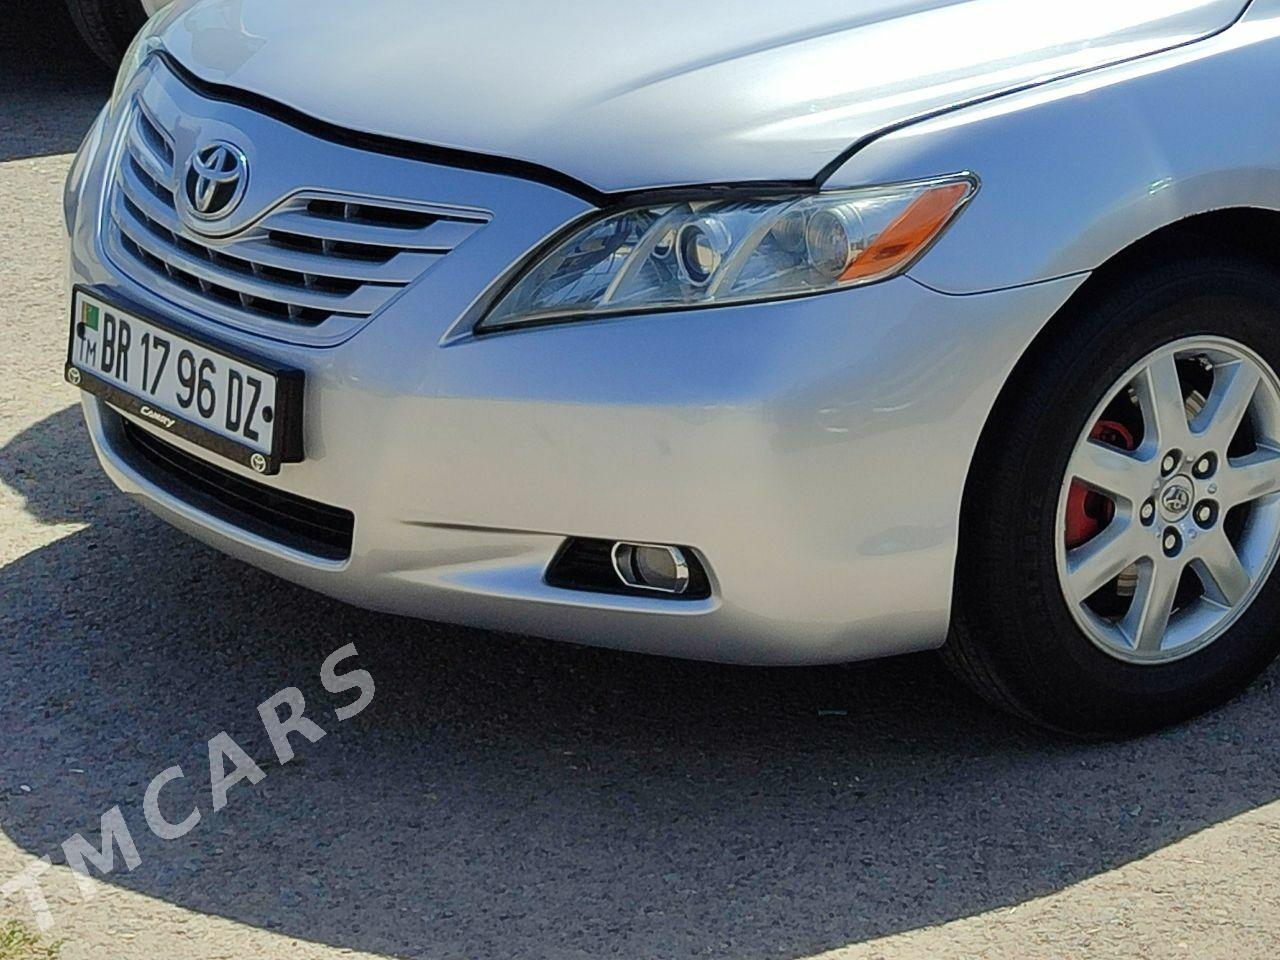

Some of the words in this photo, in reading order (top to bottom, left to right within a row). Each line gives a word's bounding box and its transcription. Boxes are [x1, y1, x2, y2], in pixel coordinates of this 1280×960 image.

[101, 312, 132, 383] BR
[141, 332, 171, 396] 17
[176, 349, 217, 419] 96
[225, 368, 262, 442] DZ
